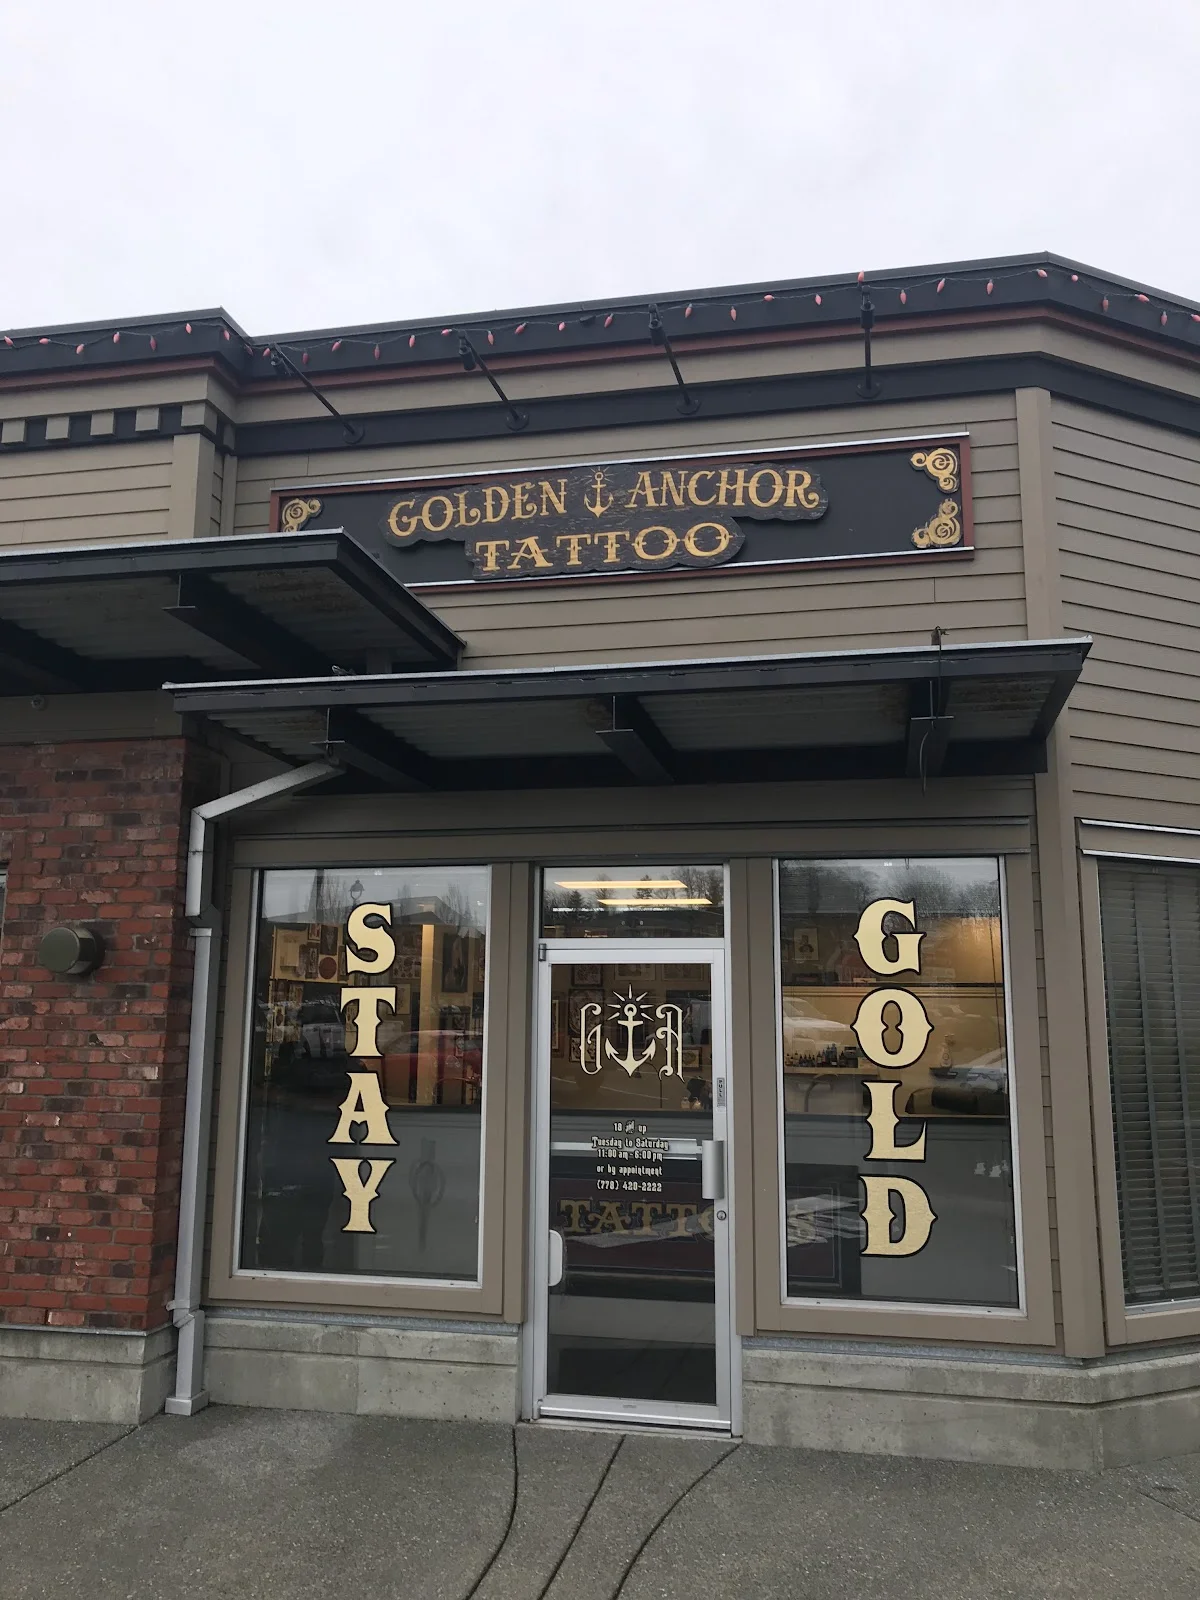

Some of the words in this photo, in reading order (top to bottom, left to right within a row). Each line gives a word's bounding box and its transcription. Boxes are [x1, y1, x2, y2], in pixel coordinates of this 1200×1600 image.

[388, 478, 568, 537] GOLDEN
[624, 468, 820, 510] ANCHOR
[475, 522, 734, 572] TATTOO
[326, 902, 400, 1233] STAY
[850, 897, 938, 1257] GOLD
[613, 1122, 622, 1132] 18
[638, 1125, 647, 1135] up
[591, 1136, 622, 1149] Tuesday
[625, 1138, 633, 1147] to
[635, 1138, 669, 1151] Saturday
[598, 1148, 617, 1158] 11:00
[596, 1165, 604, 1173] or
[607, 1163, 616, 1176] by
[619, 1165, 663, 1177] appointment
[597, 1180, 619, 1190] (778)
[622, 1181, 662, 1192] 420-2222
